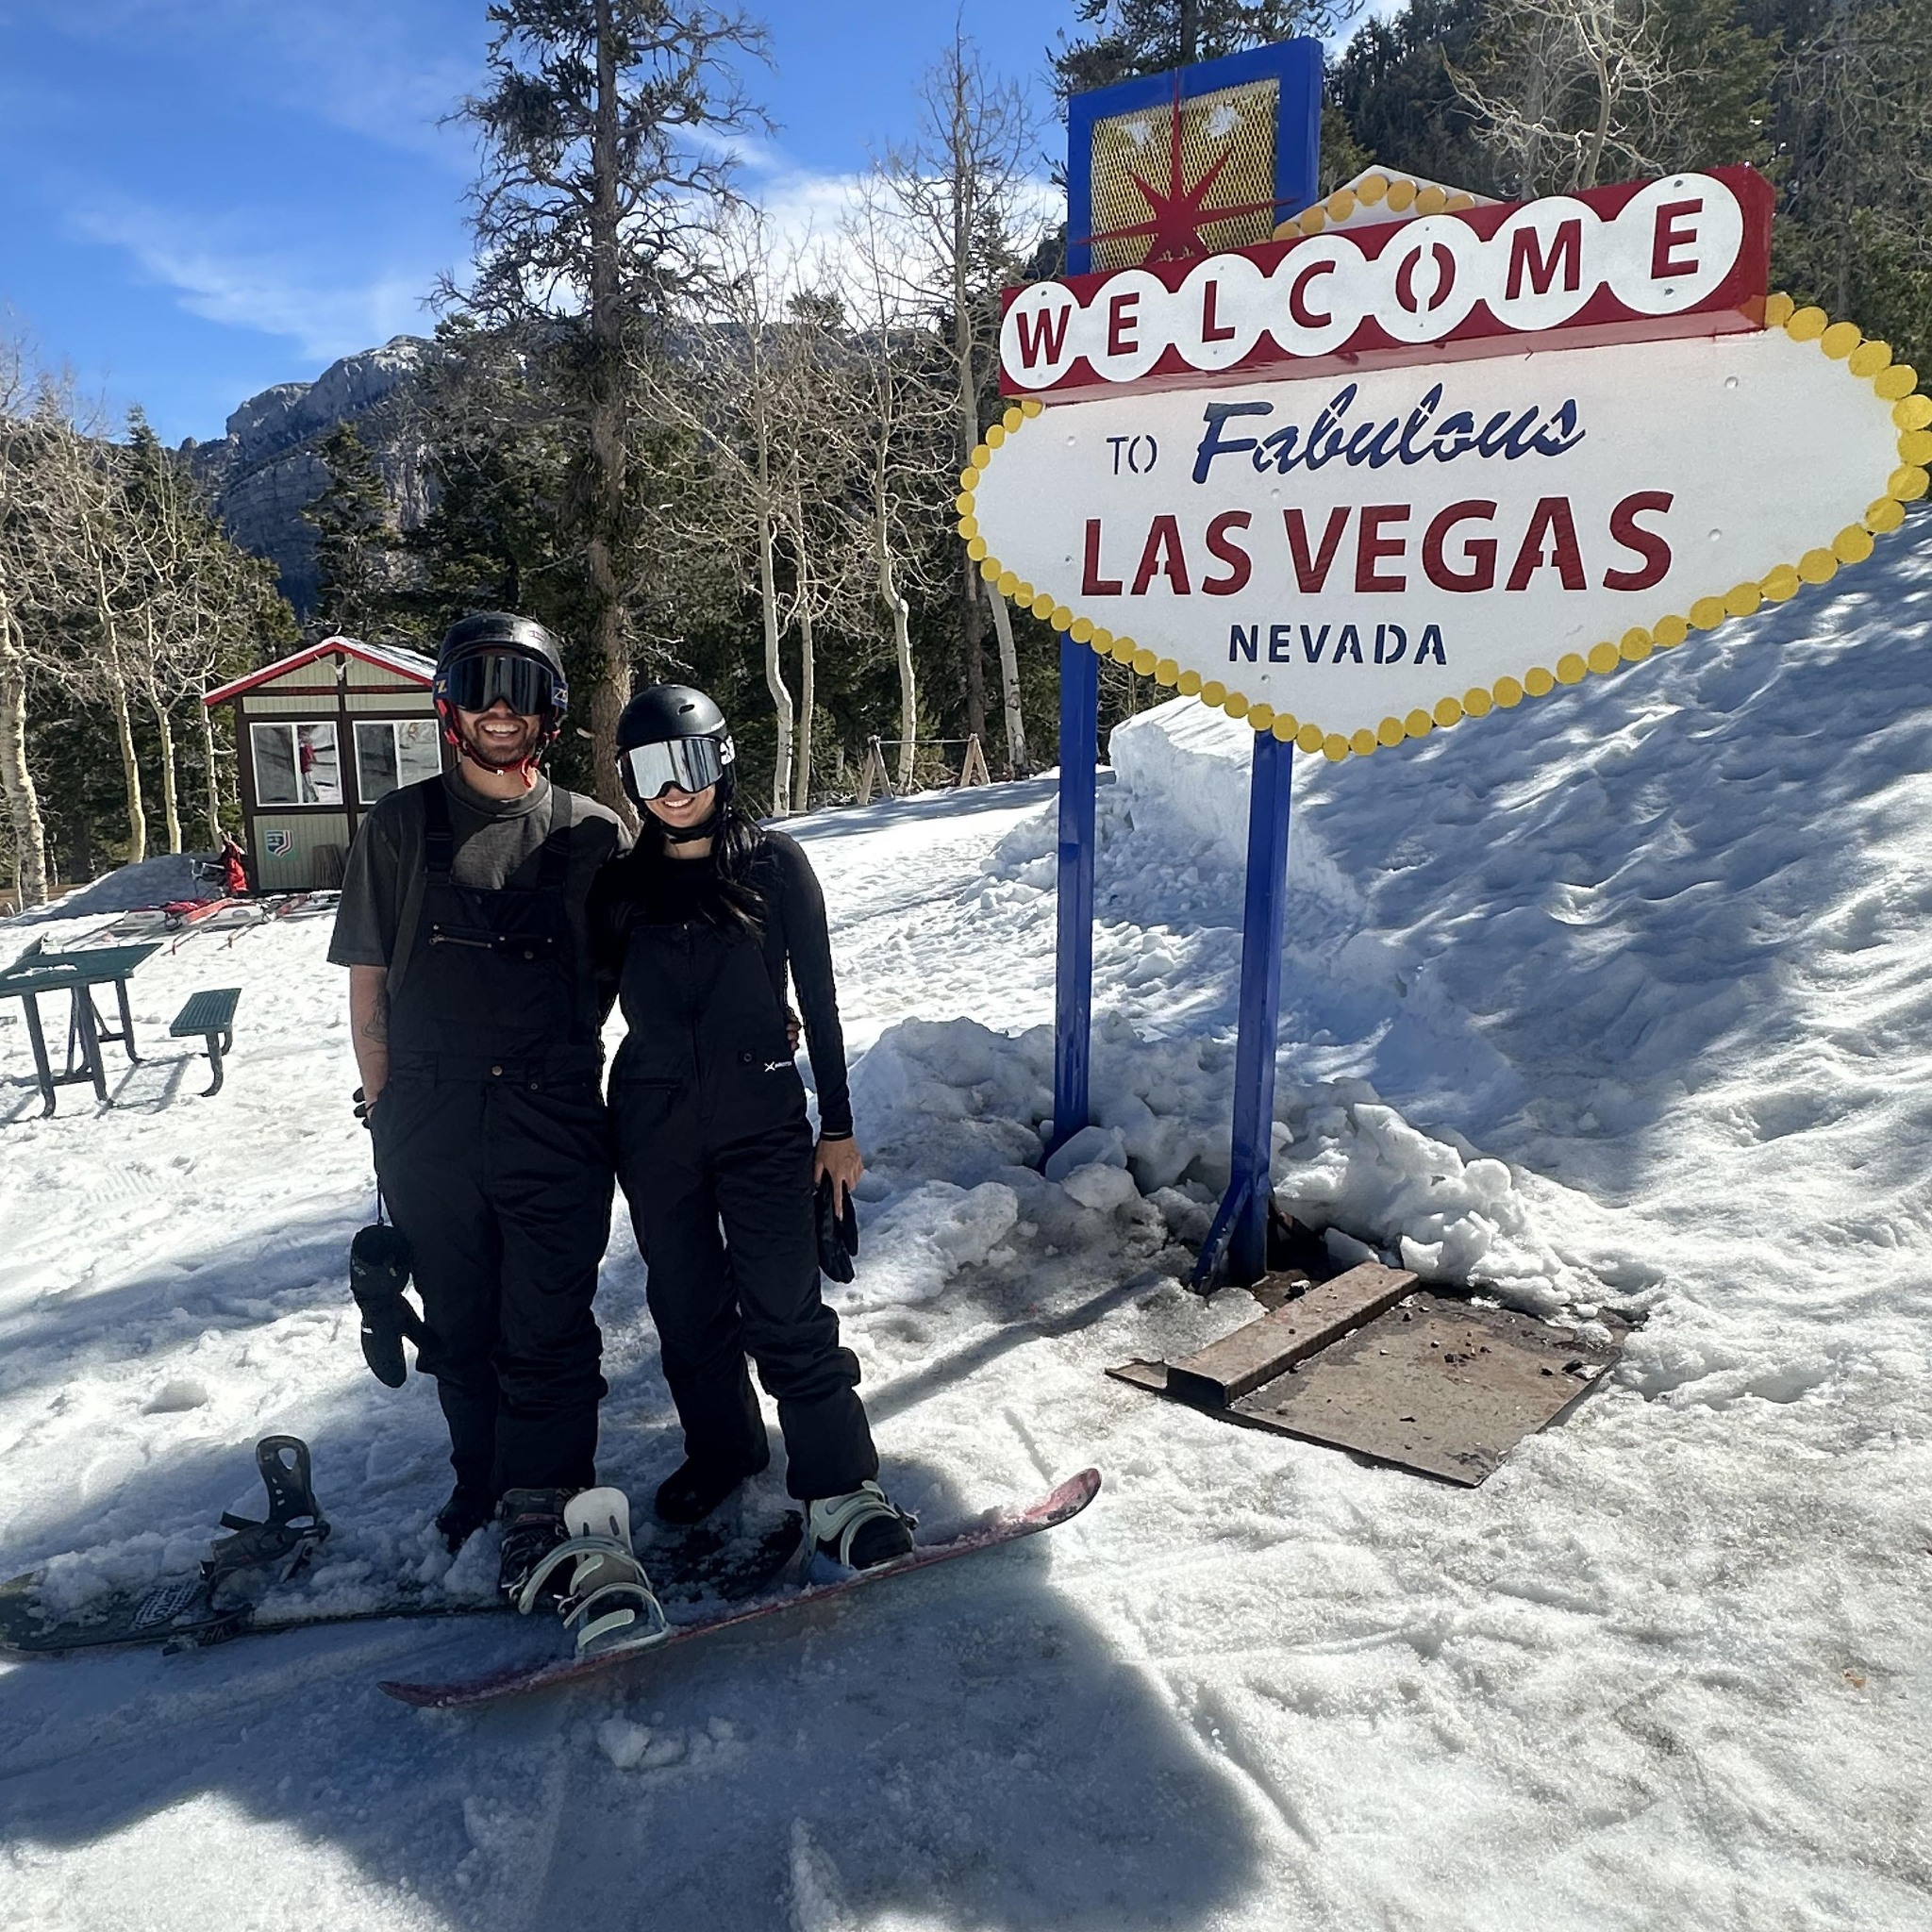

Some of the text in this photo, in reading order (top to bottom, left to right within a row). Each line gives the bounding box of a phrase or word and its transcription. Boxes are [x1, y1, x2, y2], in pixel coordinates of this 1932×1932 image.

[1015, 198, 1705, 369] WELCOME
[1107, 382, 1586, 484] TO Fabulous
[1081, 490, 1674, 595] LAS VEGAS
[1229, 624, 1446, 665] NEVADA
